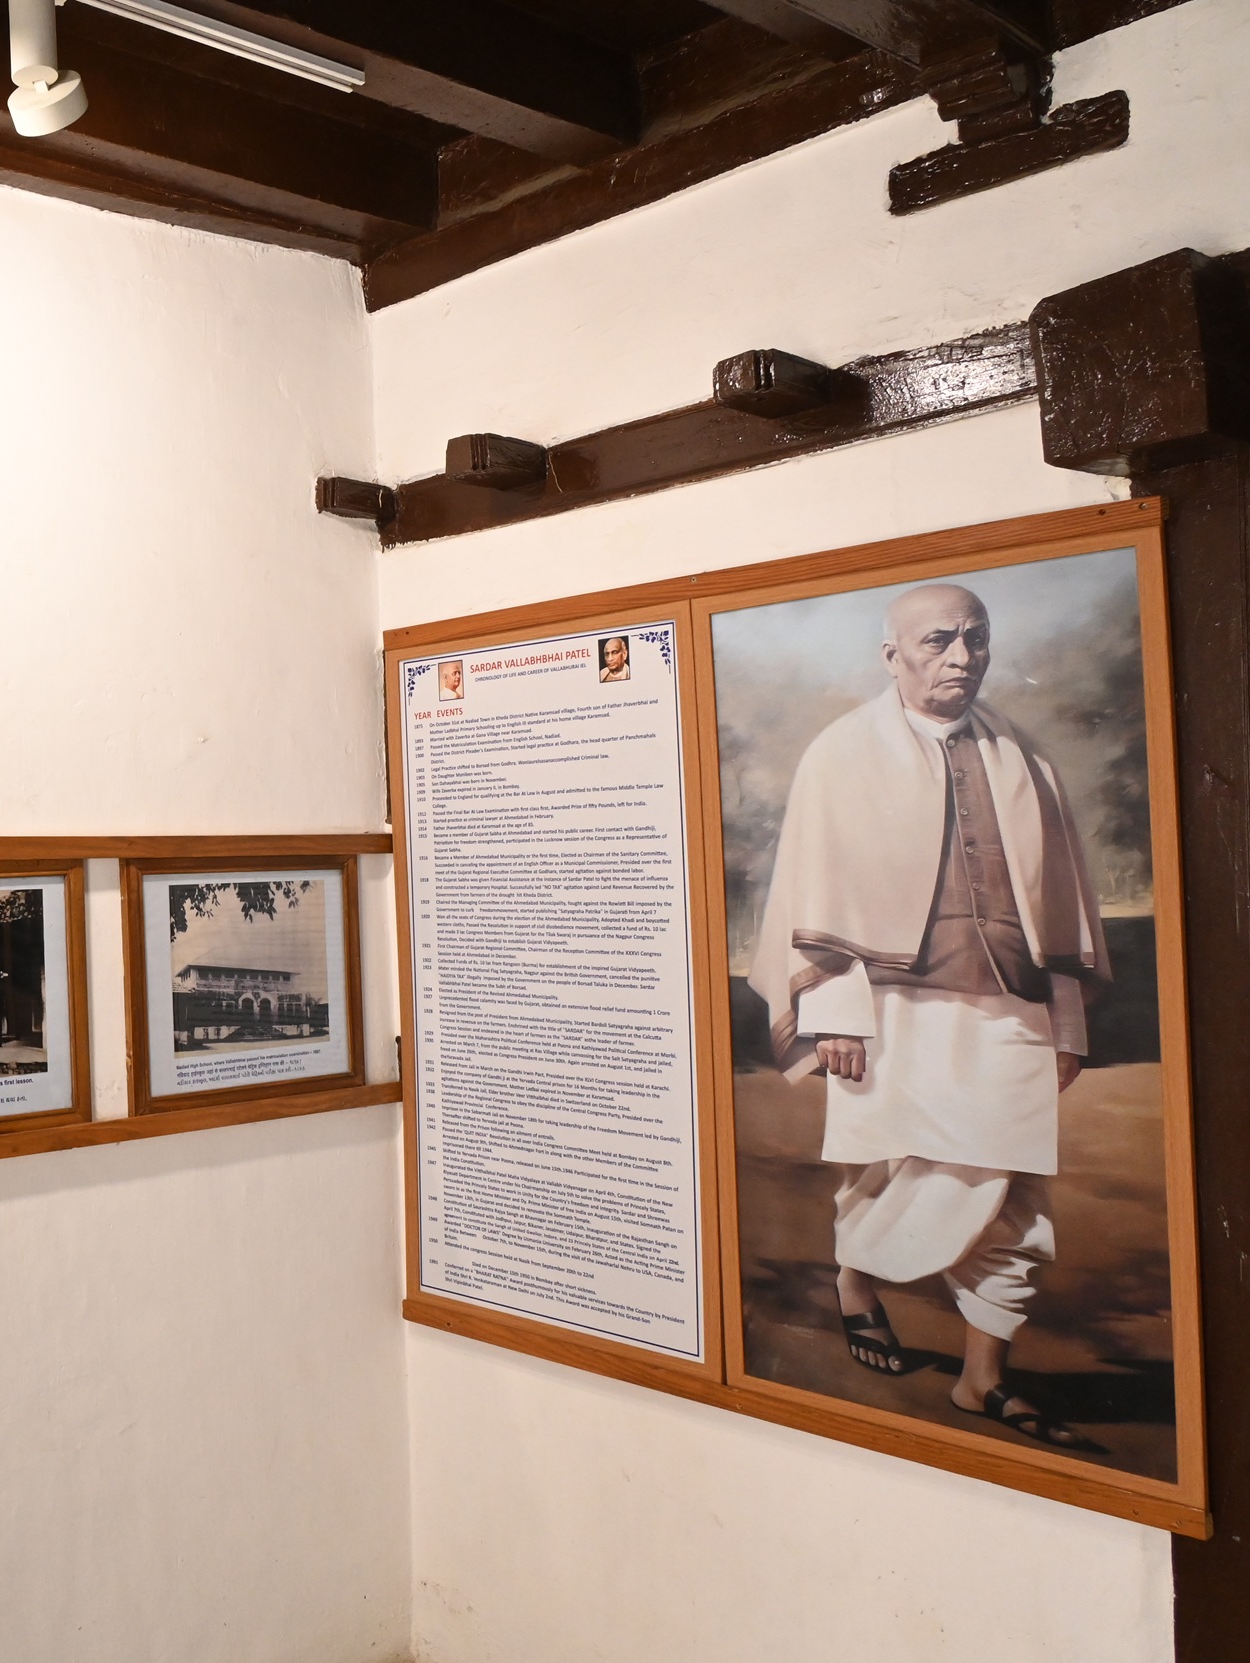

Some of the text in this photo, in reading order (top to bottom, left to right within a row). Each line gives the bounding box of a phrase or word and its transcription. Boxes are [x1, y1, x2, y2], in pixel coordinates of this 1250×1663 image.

[470, 648, 591, 674] SARDAR VALLABHBHAI PATEL
[475, 674, 502, 682] CHRONOLOGY
[414, 707, 463, 720] YEAR EVENTS
[488, 1265, 509, 1275] December
[536, 1276, 553, 1286] Bombay
